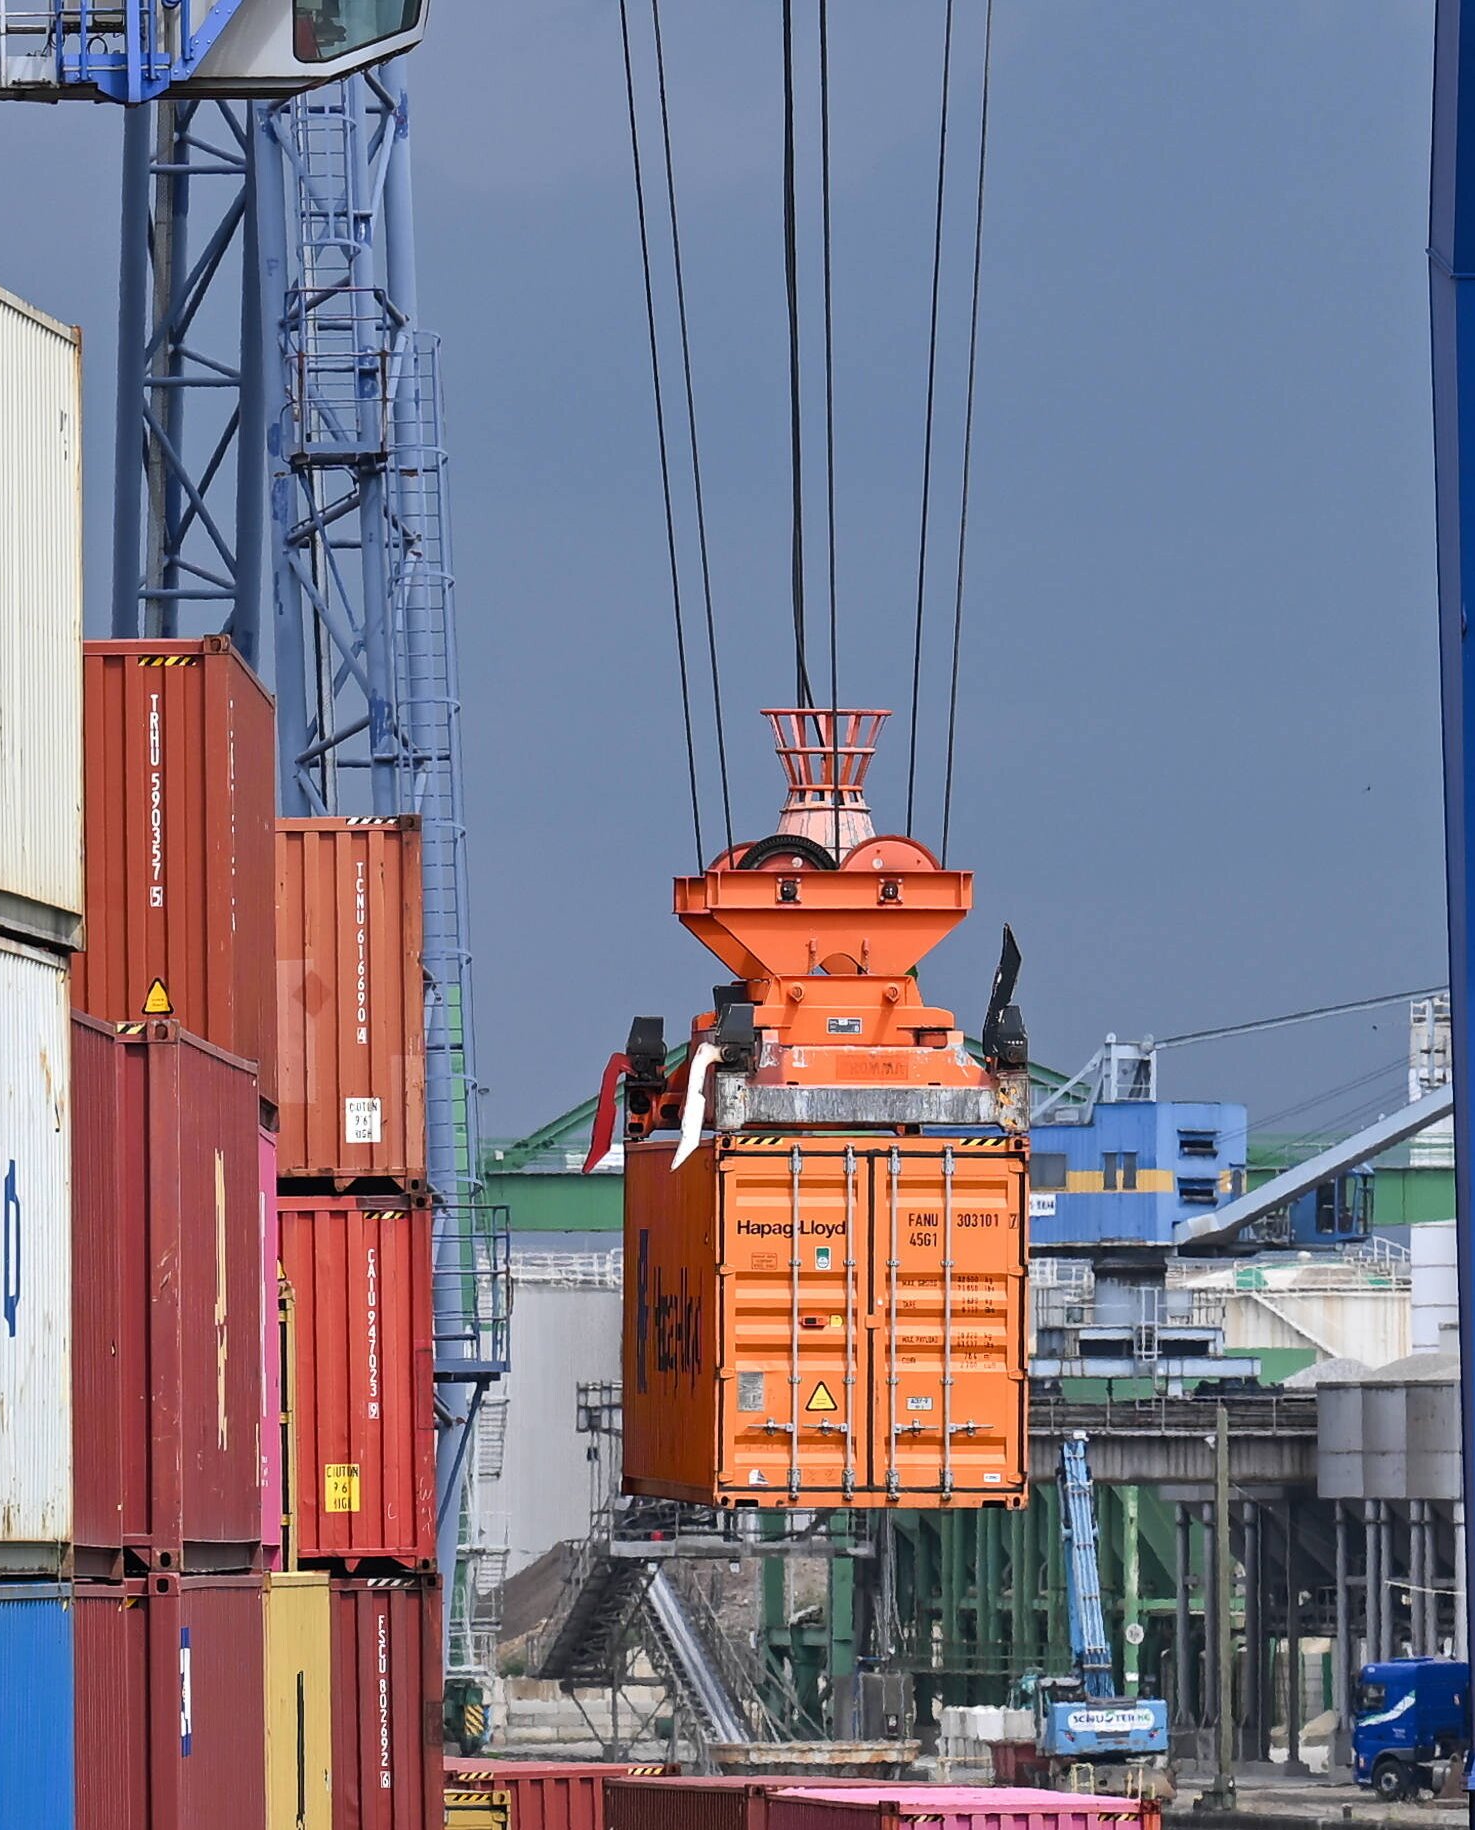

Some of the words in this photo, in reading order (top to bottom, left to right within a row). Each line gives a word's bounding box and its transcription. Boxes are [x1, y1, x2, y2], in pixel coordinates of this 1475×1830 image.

[149, 694, 161, 766] TRHU
[150, 772, 162, 881] 590357
[355, 863, 365, 925] TCNU
[356, 929, 366, 1023] 616690
[737, 1219, 847, 1239] Hapag-Lloyd
[908, 1213, 939, 1228] FANU
[956, 1213, 999, 1228] 303101
[909, 1232, 938, 1248] 45G1
[367, 1249, 376, 1307] CAIU
[367, 1310, 378, 1397] 947023
[377, 1615, 387, 1674] FSCU
[379, 1678, 389, 1767] 802692
